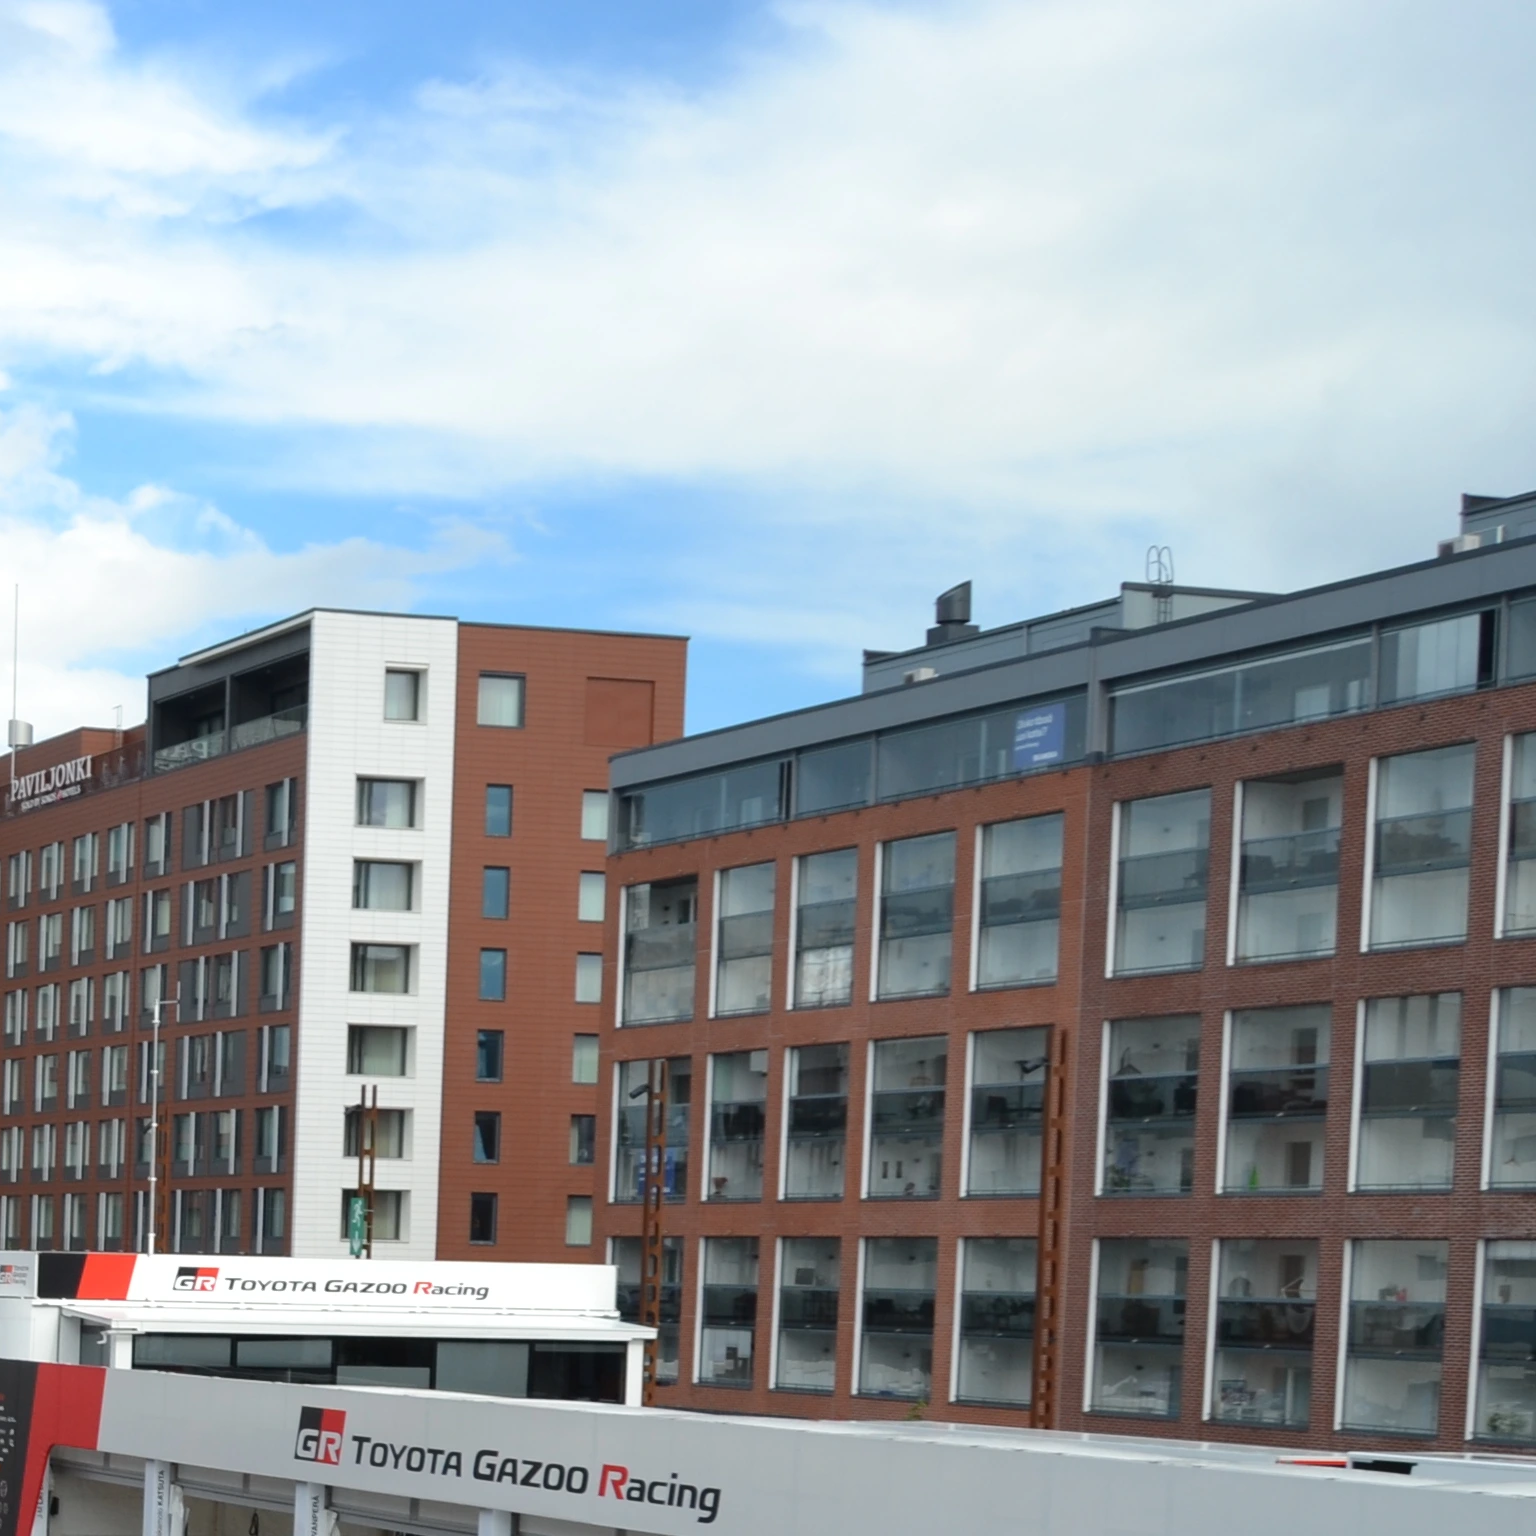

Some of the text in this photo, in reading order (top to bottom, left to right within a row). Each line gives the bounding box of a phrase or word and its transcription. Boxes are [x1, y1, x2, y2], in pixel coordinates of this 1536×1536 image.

[11, 755, 92, 801] PAVILJONKI
[174, 1275, 489, 1300] GR TOYOTA GAZOO Racing
[296, 1428, 721, 1524] GR TOYOTA GAZOO Racing
